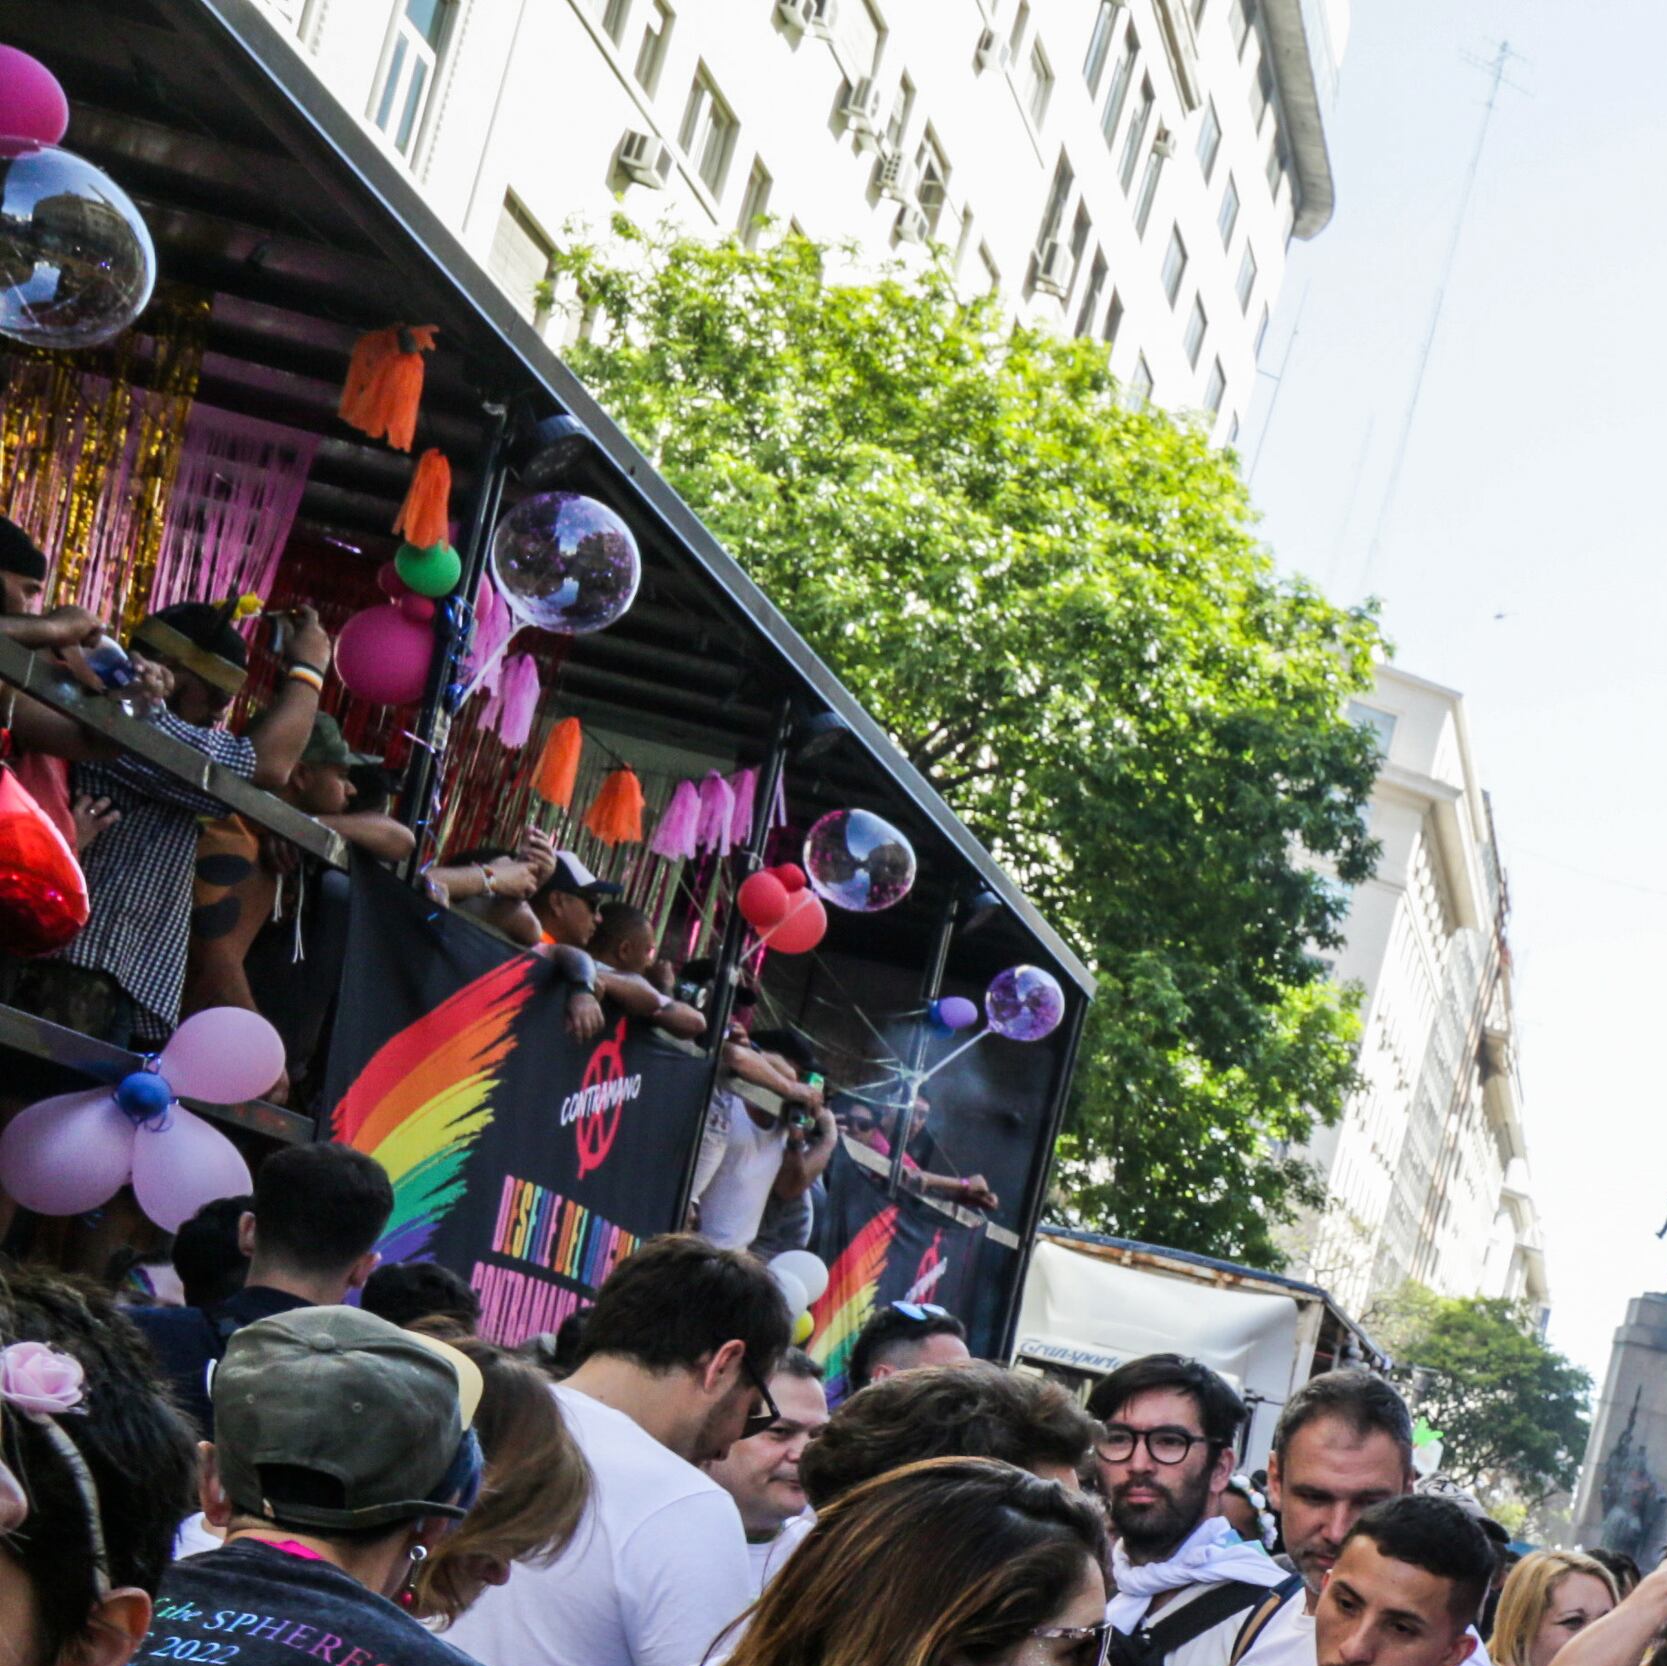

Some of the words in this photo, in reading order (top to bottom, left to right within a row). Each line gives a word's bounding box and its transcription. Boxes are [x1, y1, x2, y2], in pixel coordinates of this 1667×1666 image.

[560, 1074, 641, 1126] CONTRAMANO
[492, 1174, 563, 1268] DESFILE
[553, 1199, 590, 1280] DEL
[149, 1636, 240, 1665] 2022
